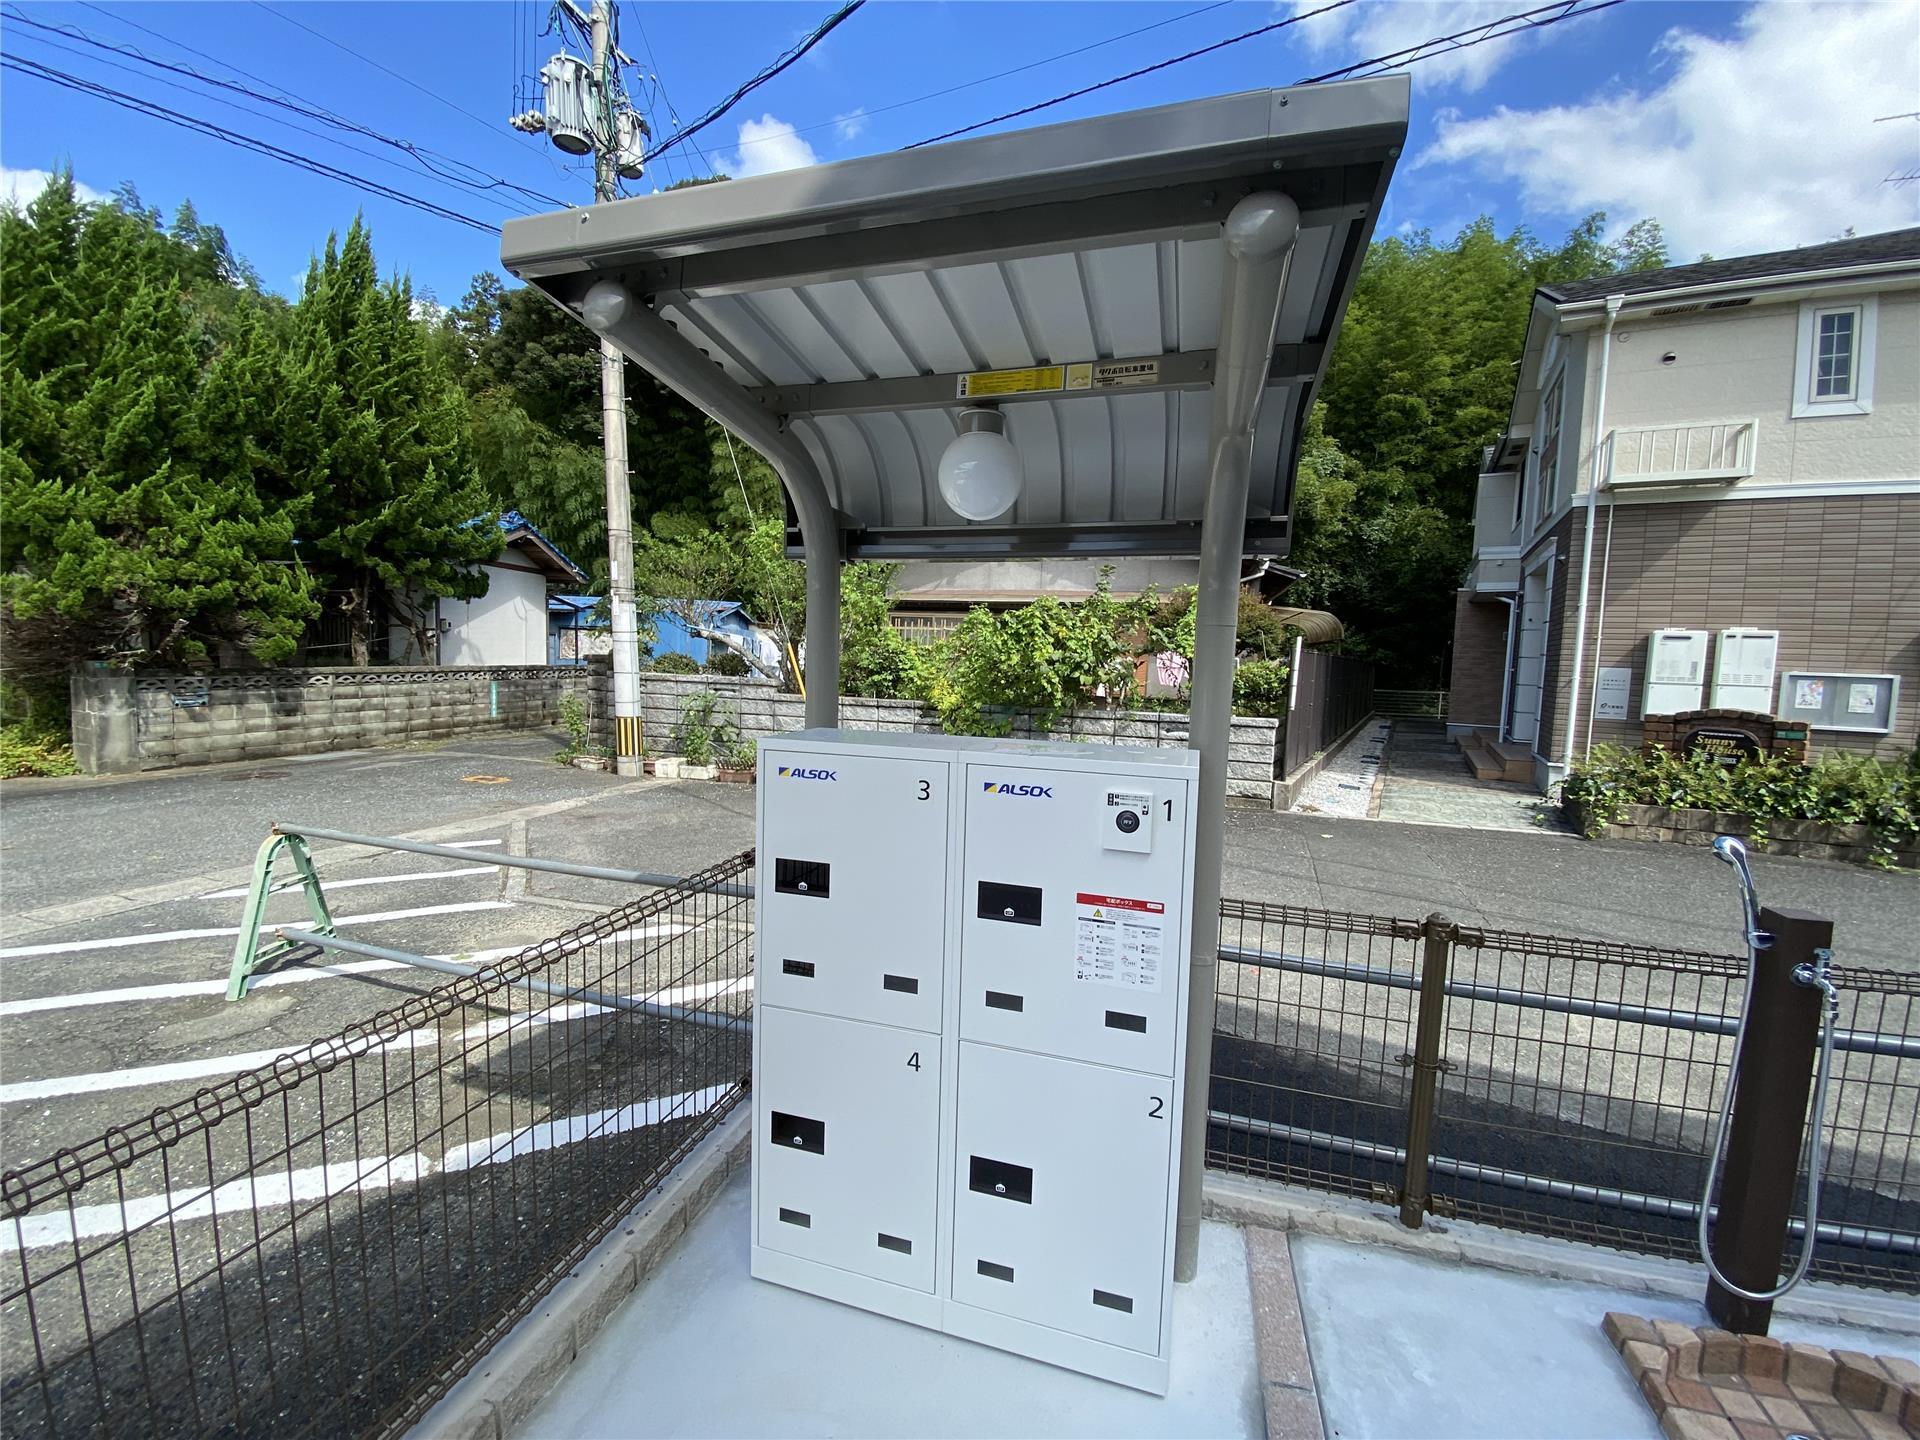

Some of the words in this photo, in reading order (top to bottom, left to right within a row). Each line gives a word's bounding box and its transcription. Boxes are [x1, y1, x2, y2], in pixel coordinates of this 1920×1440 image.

[1695, 735, 1737, 749] Sunny
[1704, 745, 1745, 756] House
[791, 767, 837, 782] ALSOK
[917, 779, 931, 801] 3
[998, 783, 1053, 798] ALSOK
[1162, 799, 1173, 822] 1
[1105, 897, 1133, 906] 宅配ボックス
[906, 1051, 922, 1073] 4
[1148, 1096, 1164, 1119] 2
